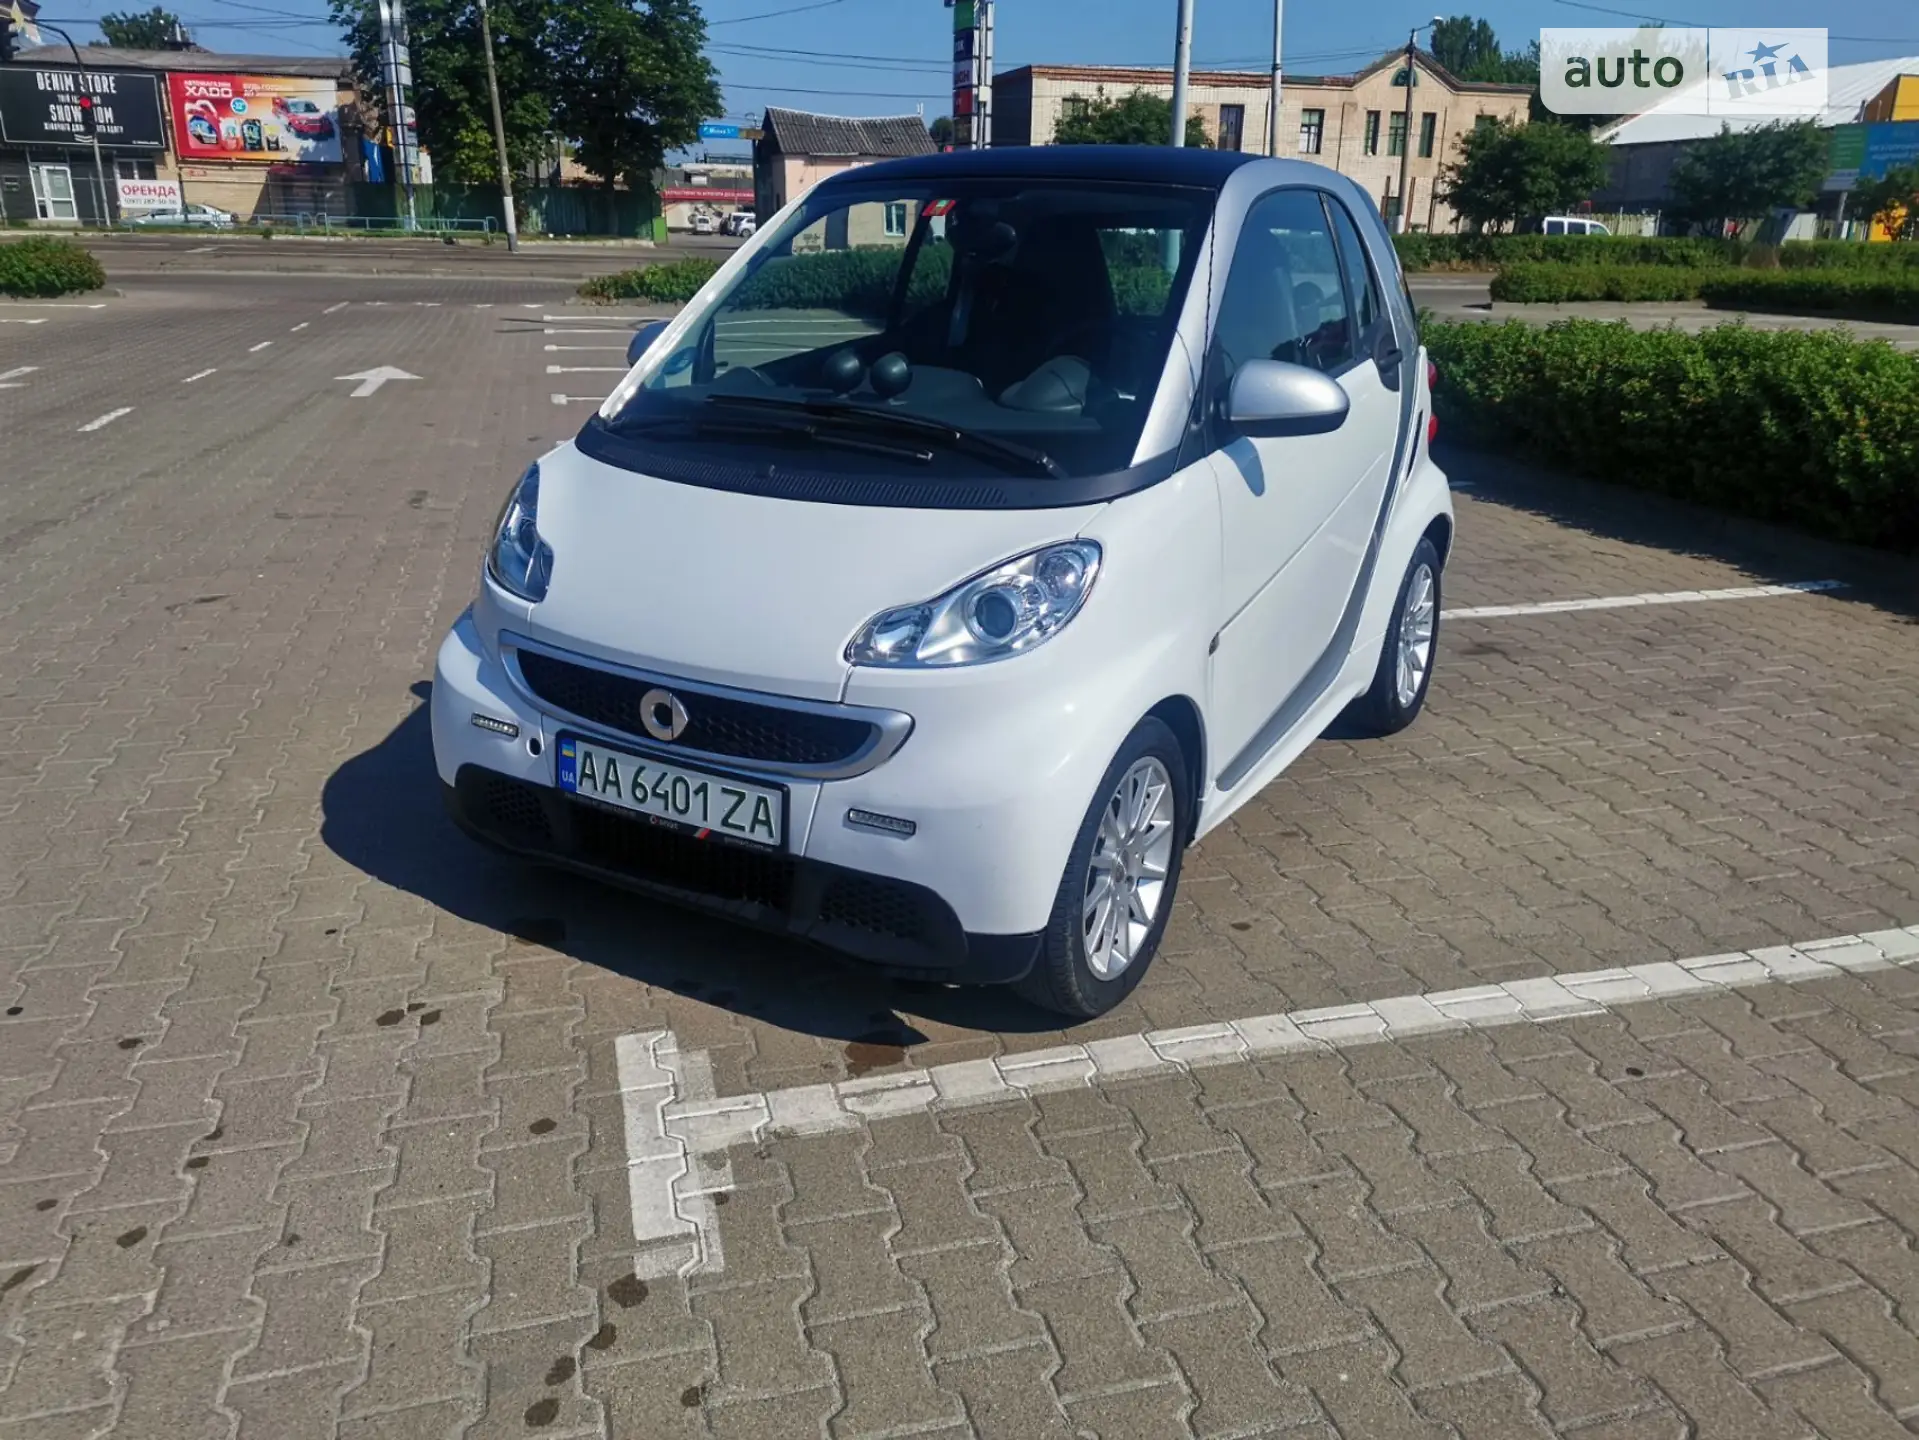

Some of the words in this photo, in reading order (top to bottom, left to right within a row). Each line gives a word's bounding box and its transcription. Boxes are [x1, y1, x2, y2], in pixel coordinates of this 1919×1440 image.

[36, 72, 74, 92] DENIM
[79, 74, 117, 94] STORE
[185, 85, 233, 98] XADO
[49, 104, 114, 124] SHOWOM
[121, 184, 177, 198] ОРЕНДА
[562, 770, 575, 784] UA
[578, 751, 623, 799] AA
[631, 765, 709, 822] 6401
[720, 786, 775, 839] ZA
